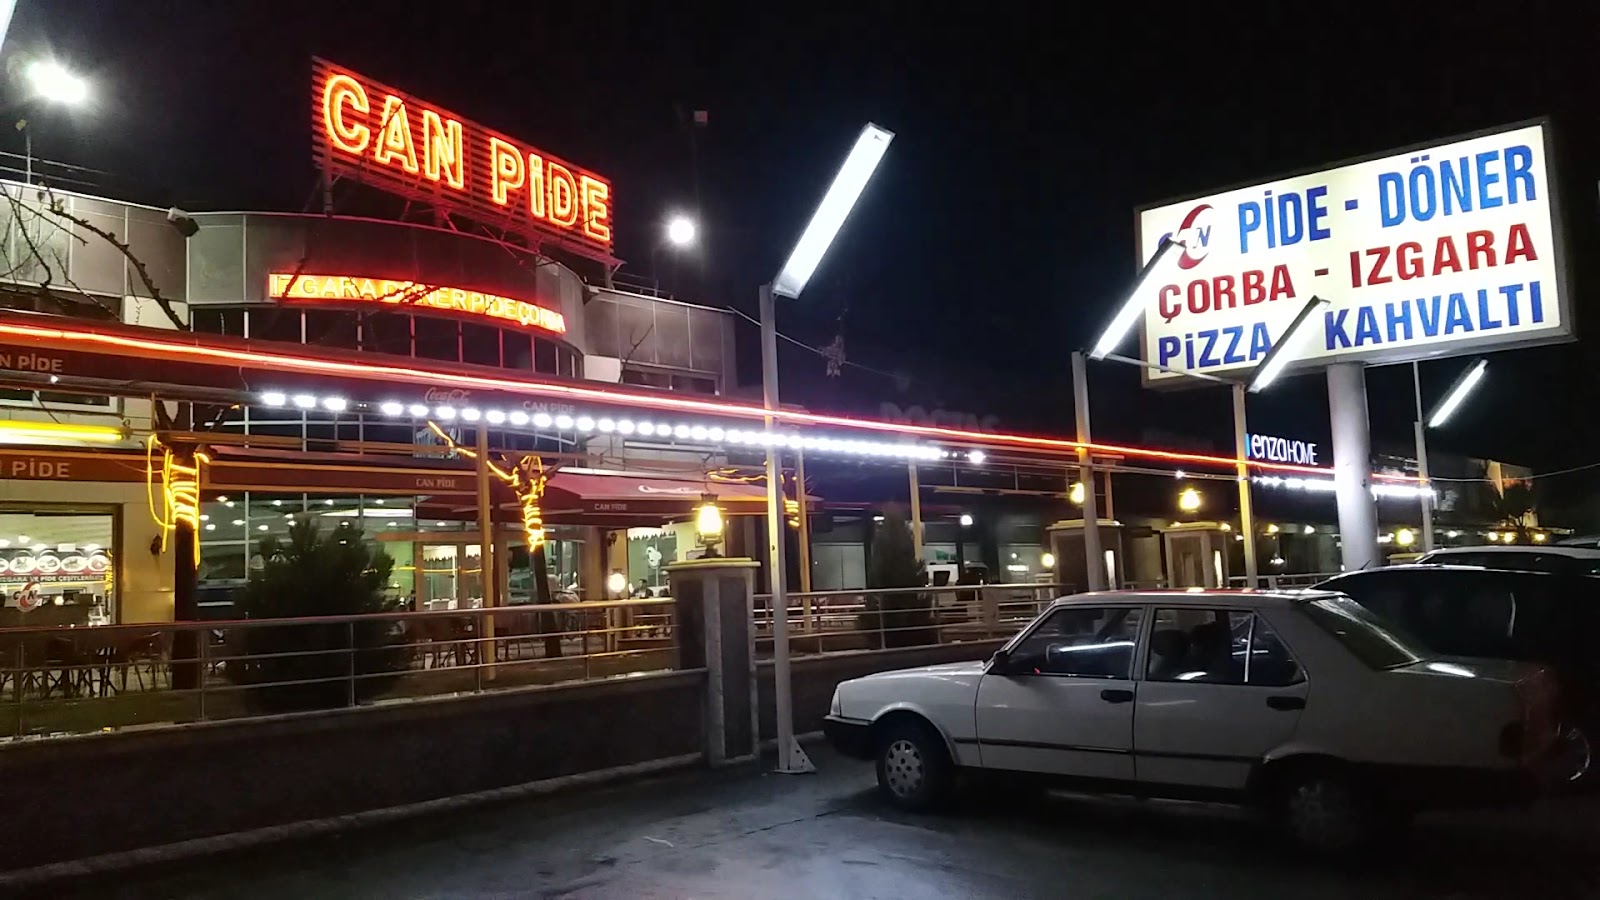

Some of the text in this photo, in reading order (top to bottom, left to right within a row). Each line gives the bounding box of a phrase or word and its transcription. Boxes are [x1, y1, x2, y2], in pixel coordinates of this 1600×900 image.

[323, 74, 465, 190] CAN
[1238, 144, 1537, 254] PİDE - DÖNER
[382, 280, 467, 310] DNER
[1158, 222, 1539, 324] ÇORBA - IZGARA
[1324, 280, 1545, 351] KAHVALTI
[523, 400, 548, 413] CAN
[416, 478, 435, 487] CAN
[594, 503, 610, 511] CAN
